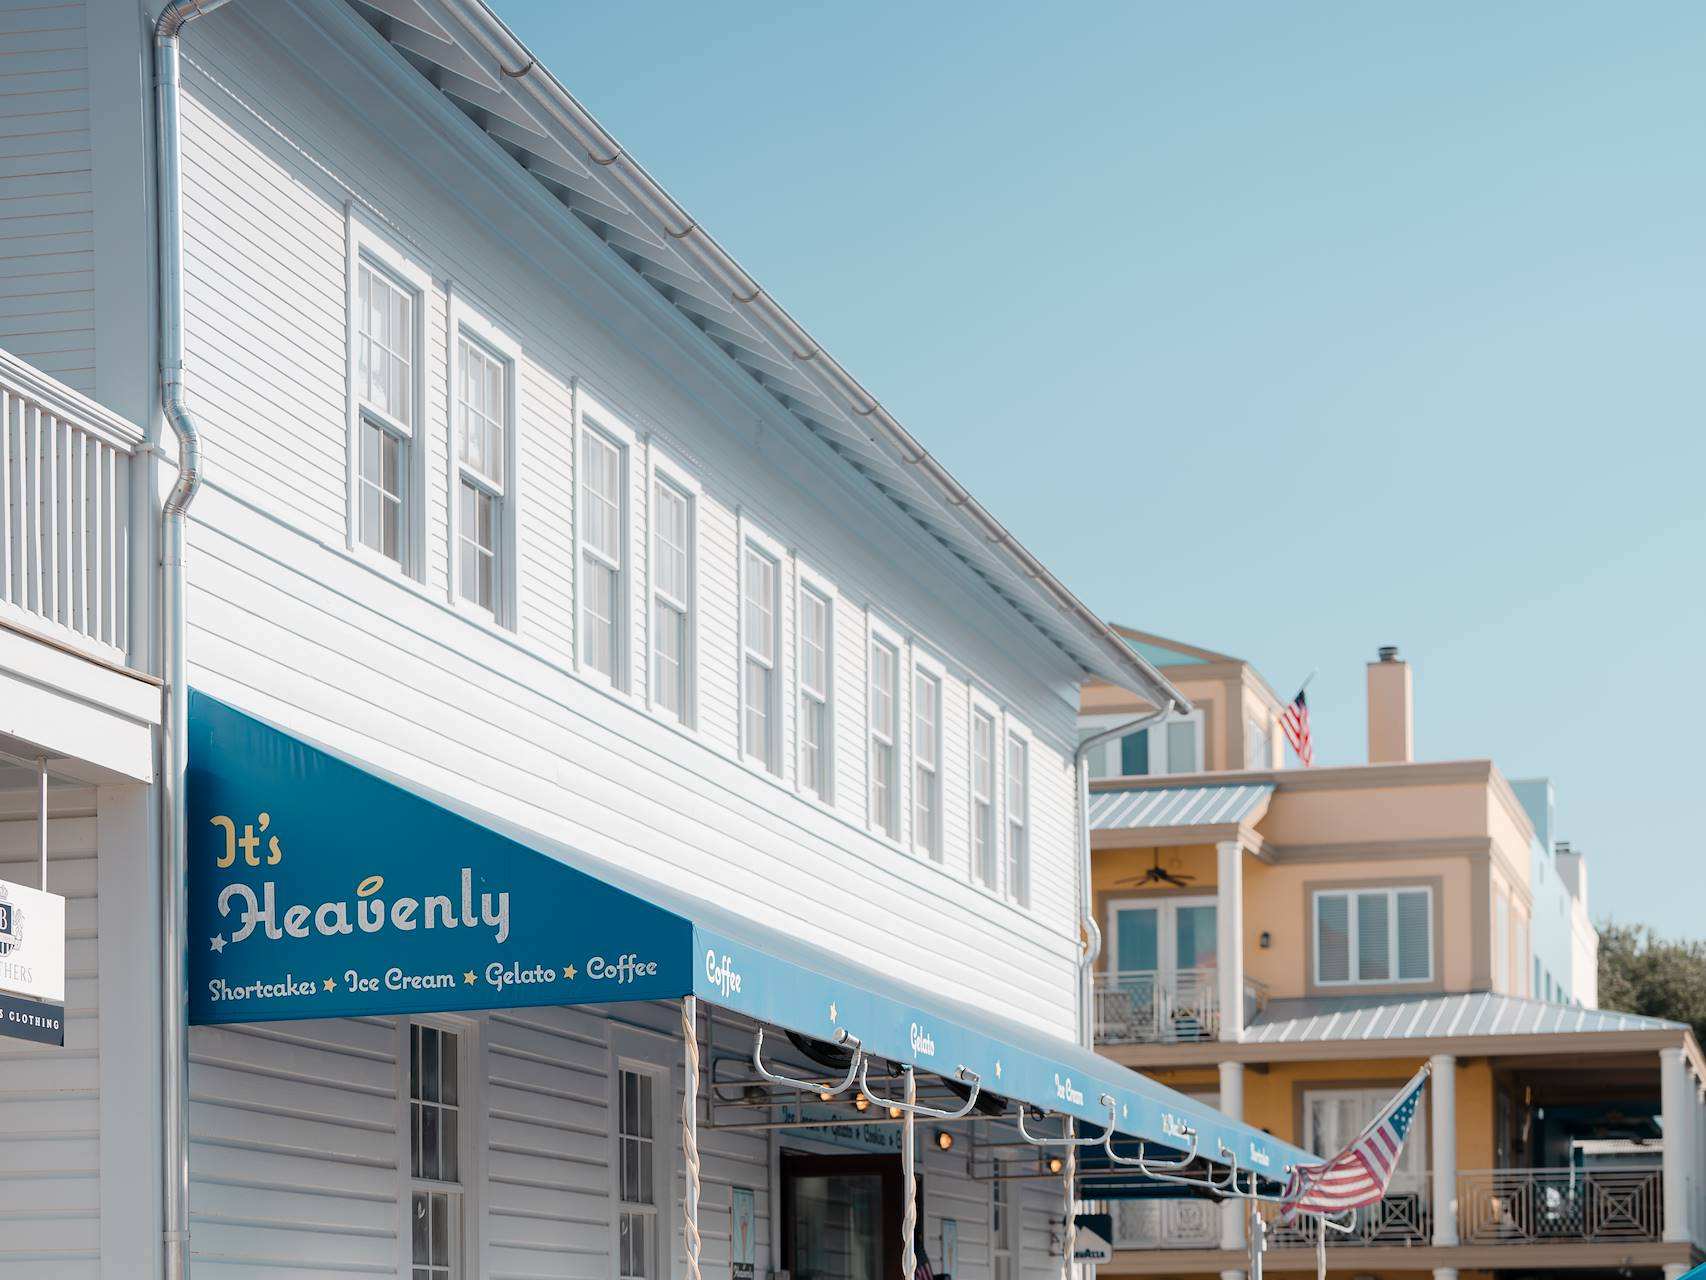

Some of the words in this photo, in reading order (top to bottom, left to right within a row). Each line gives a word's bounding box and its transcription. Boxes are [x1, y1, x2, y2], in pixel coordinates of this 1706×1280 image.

[210, 812, 282, 867] It's
[217, 868, 509, 943] Heavenly
[209, 974, 316, 1001] Shortcakes
[344, 969, 379, 993] Ice
[384, 968, 455, 991] Cream
[485, 963, 555, 990] Gelato
[586, 954, 657, 983] Coffee
[706, 950, 741, 997] Coffee
[9, 1011, 59, 1029] CLOTHING
[910, 1022, 935, 1058] Gelato
